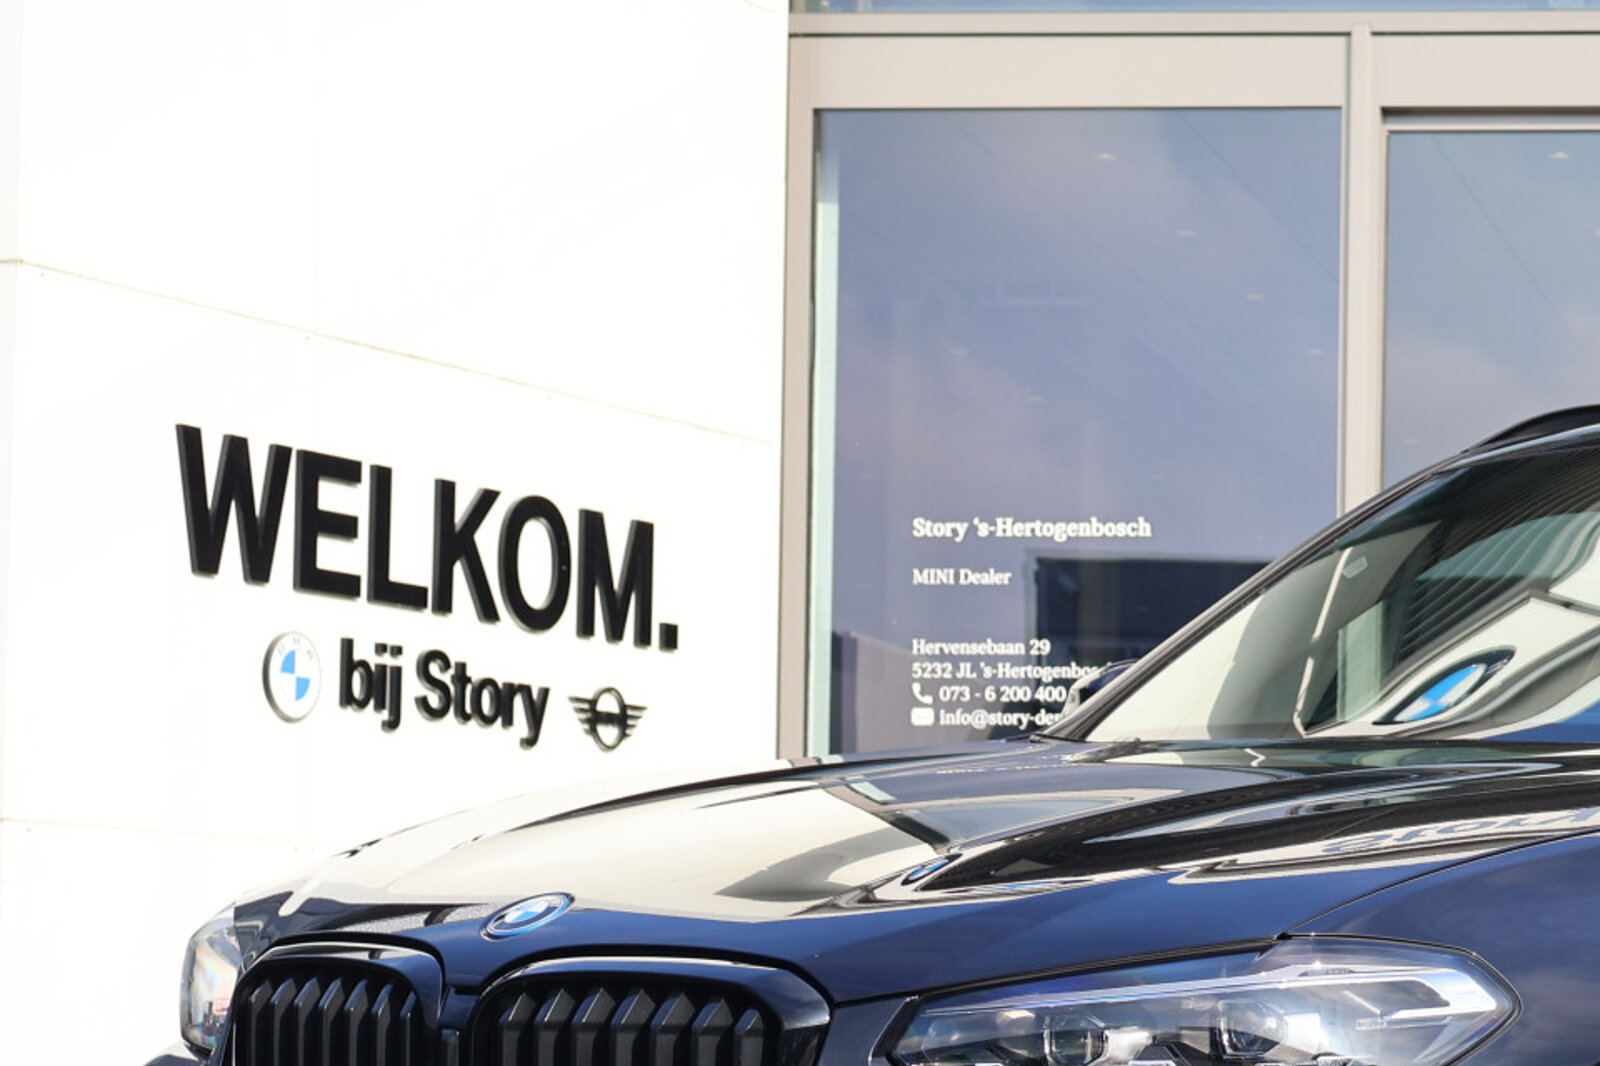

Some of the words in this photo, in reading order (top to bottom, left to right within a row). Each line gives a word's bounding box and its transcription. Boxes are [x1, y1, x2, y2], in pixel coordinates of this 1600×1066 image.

[175, 422, 679, 652] WELKOM.
[912, 517, 968, 542] Story
[912, 568, 955, 585] MINI
[959, 568, 1012, 585] Dealer
[911, 638, 1026, 655] Hervensebaan
[1029, 638, 1051, 655] 29
[911, 662, 952, 678] 5232
[956, 662, 977, 678] JL
[980, 662, 1113, 682] 's-Hertogenbo
[339, 637, 402, 732] bij
[415, 649, 550, 748] Story
[939, 686, 970, 702] 073
[985, 686, 996, 702] 6
[1000, 686, 1031, 702] 200
[1034, 686, 1067, 702] 400
